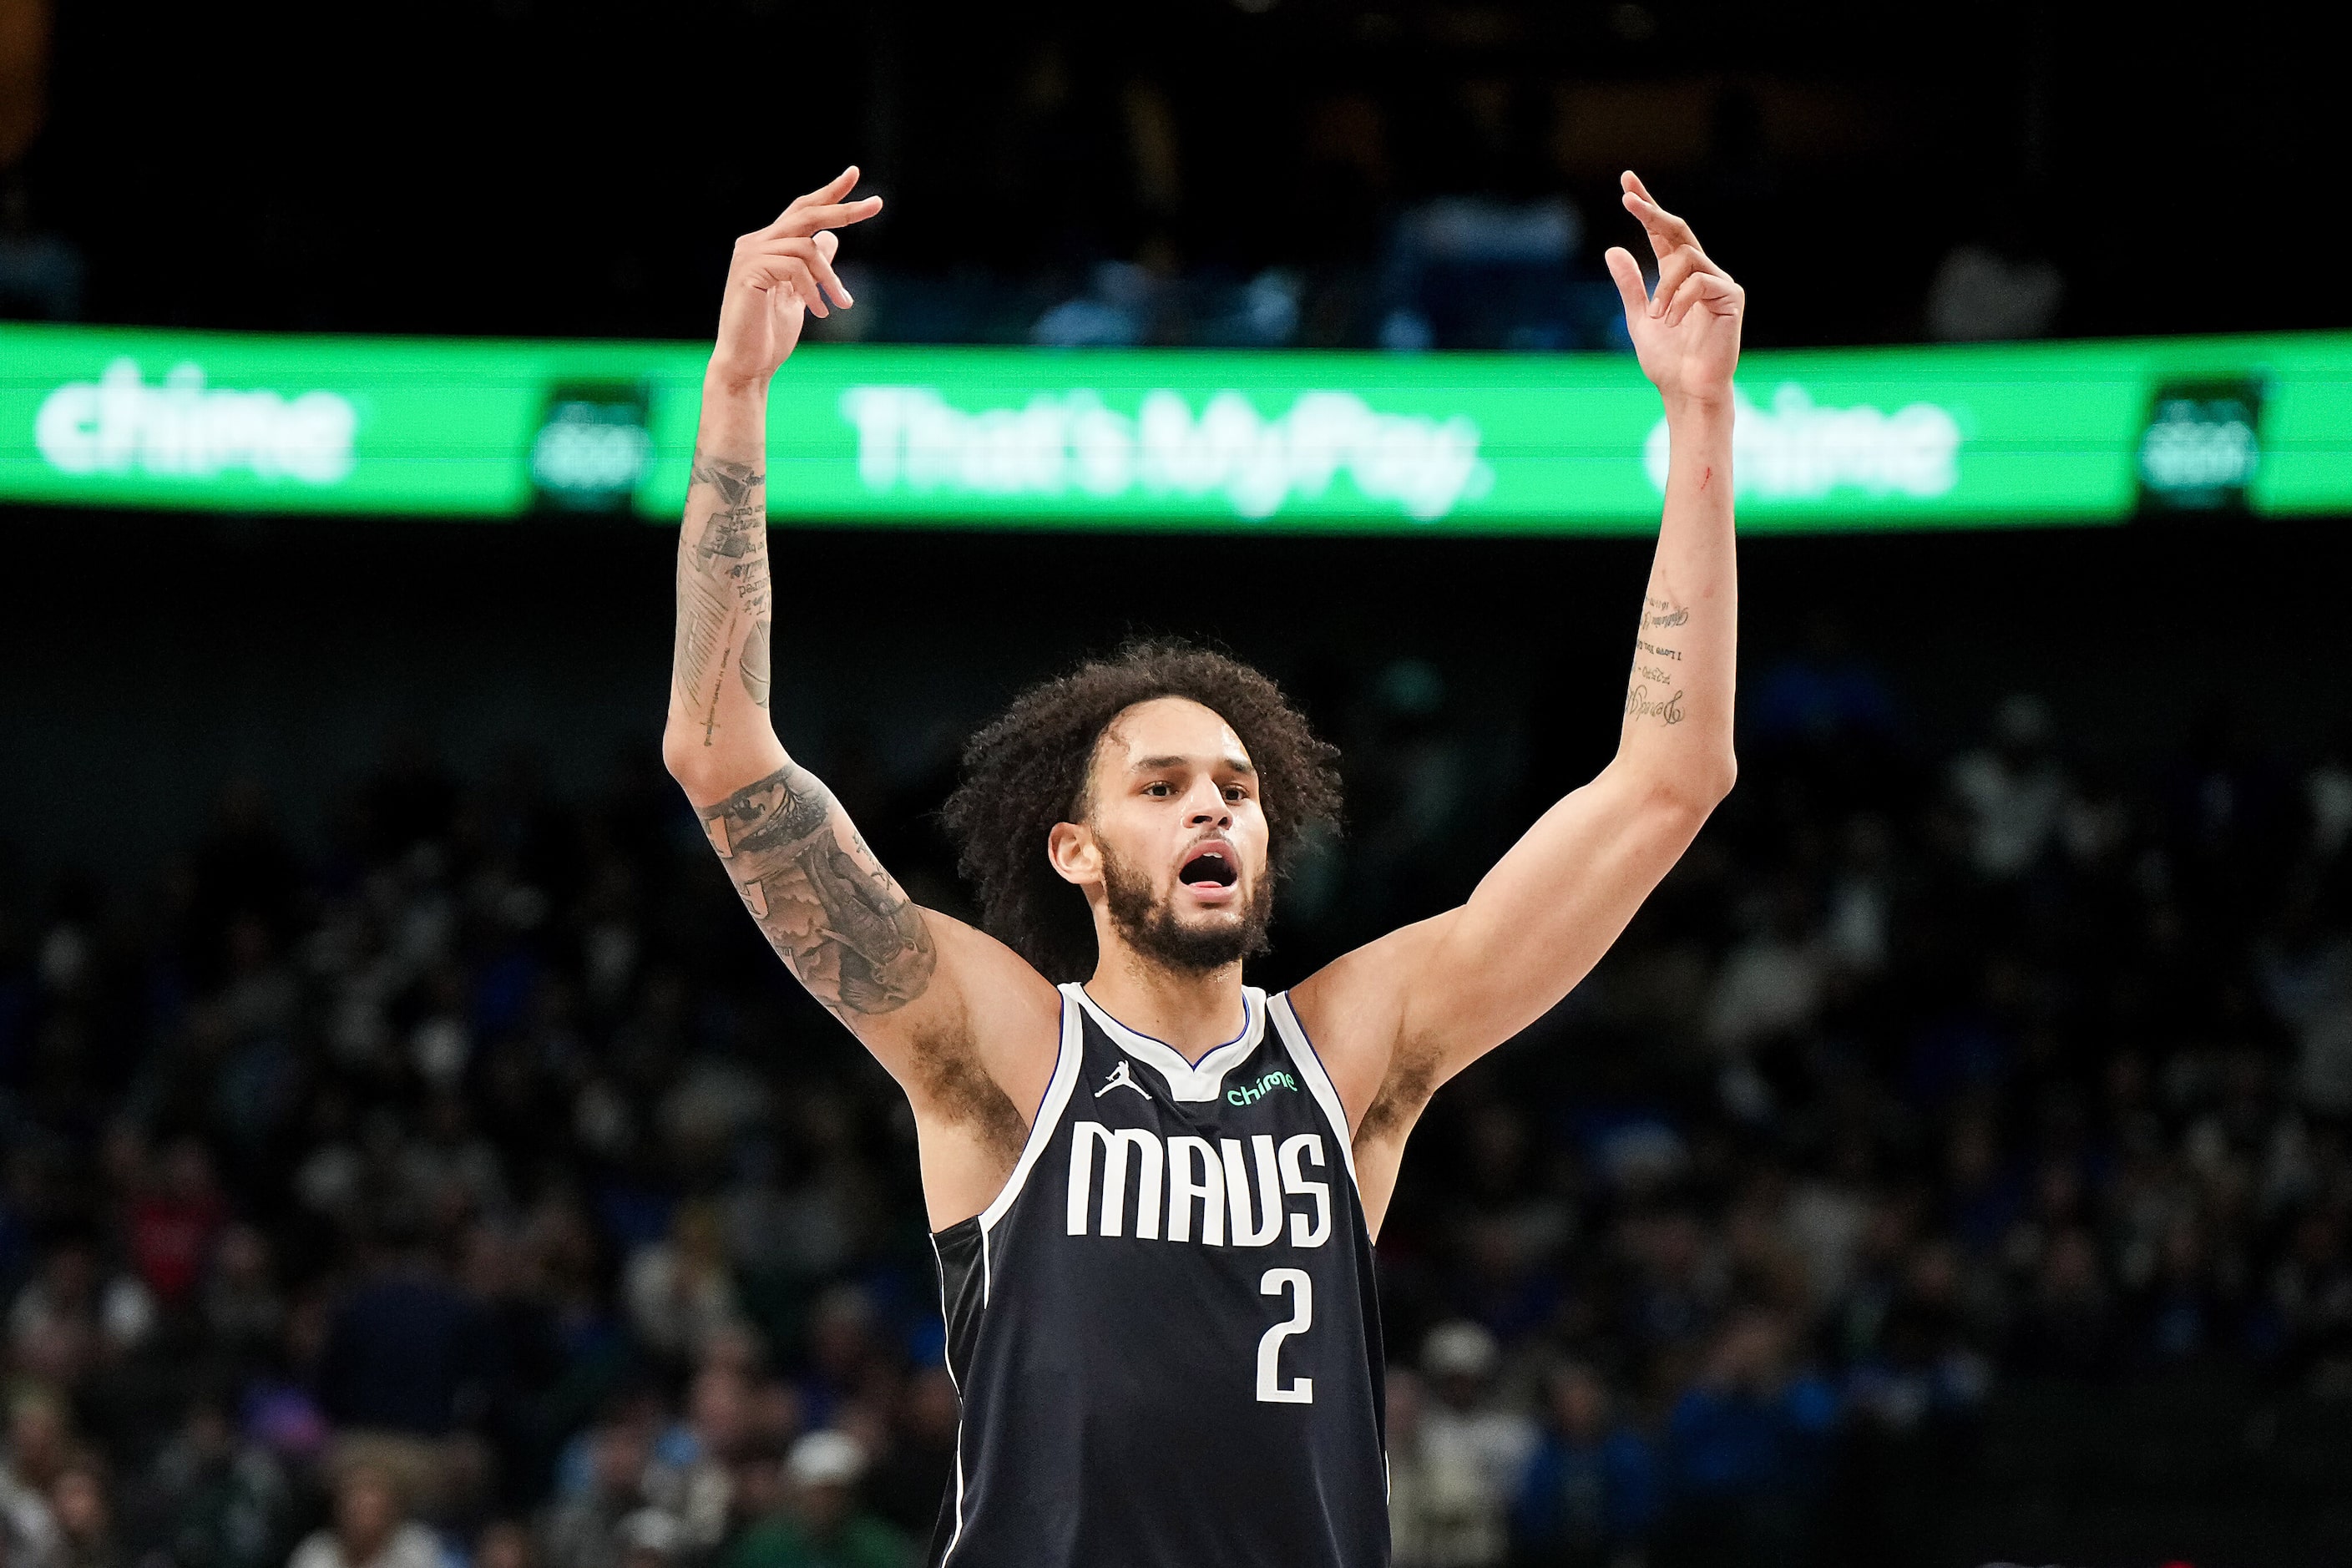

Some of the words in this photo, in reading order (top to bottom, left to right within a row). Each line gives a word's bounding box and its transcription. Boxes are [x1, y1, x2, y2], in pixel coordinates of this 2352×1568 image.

[35, 357, 357, 485] chime
[837, 386, 1138, 498] That's
[1227, 1070, 1298, 1106] chime
[1066, 1120, 1332, 1248] MAVS
[1256, 1267, 1313, 1404] 2
